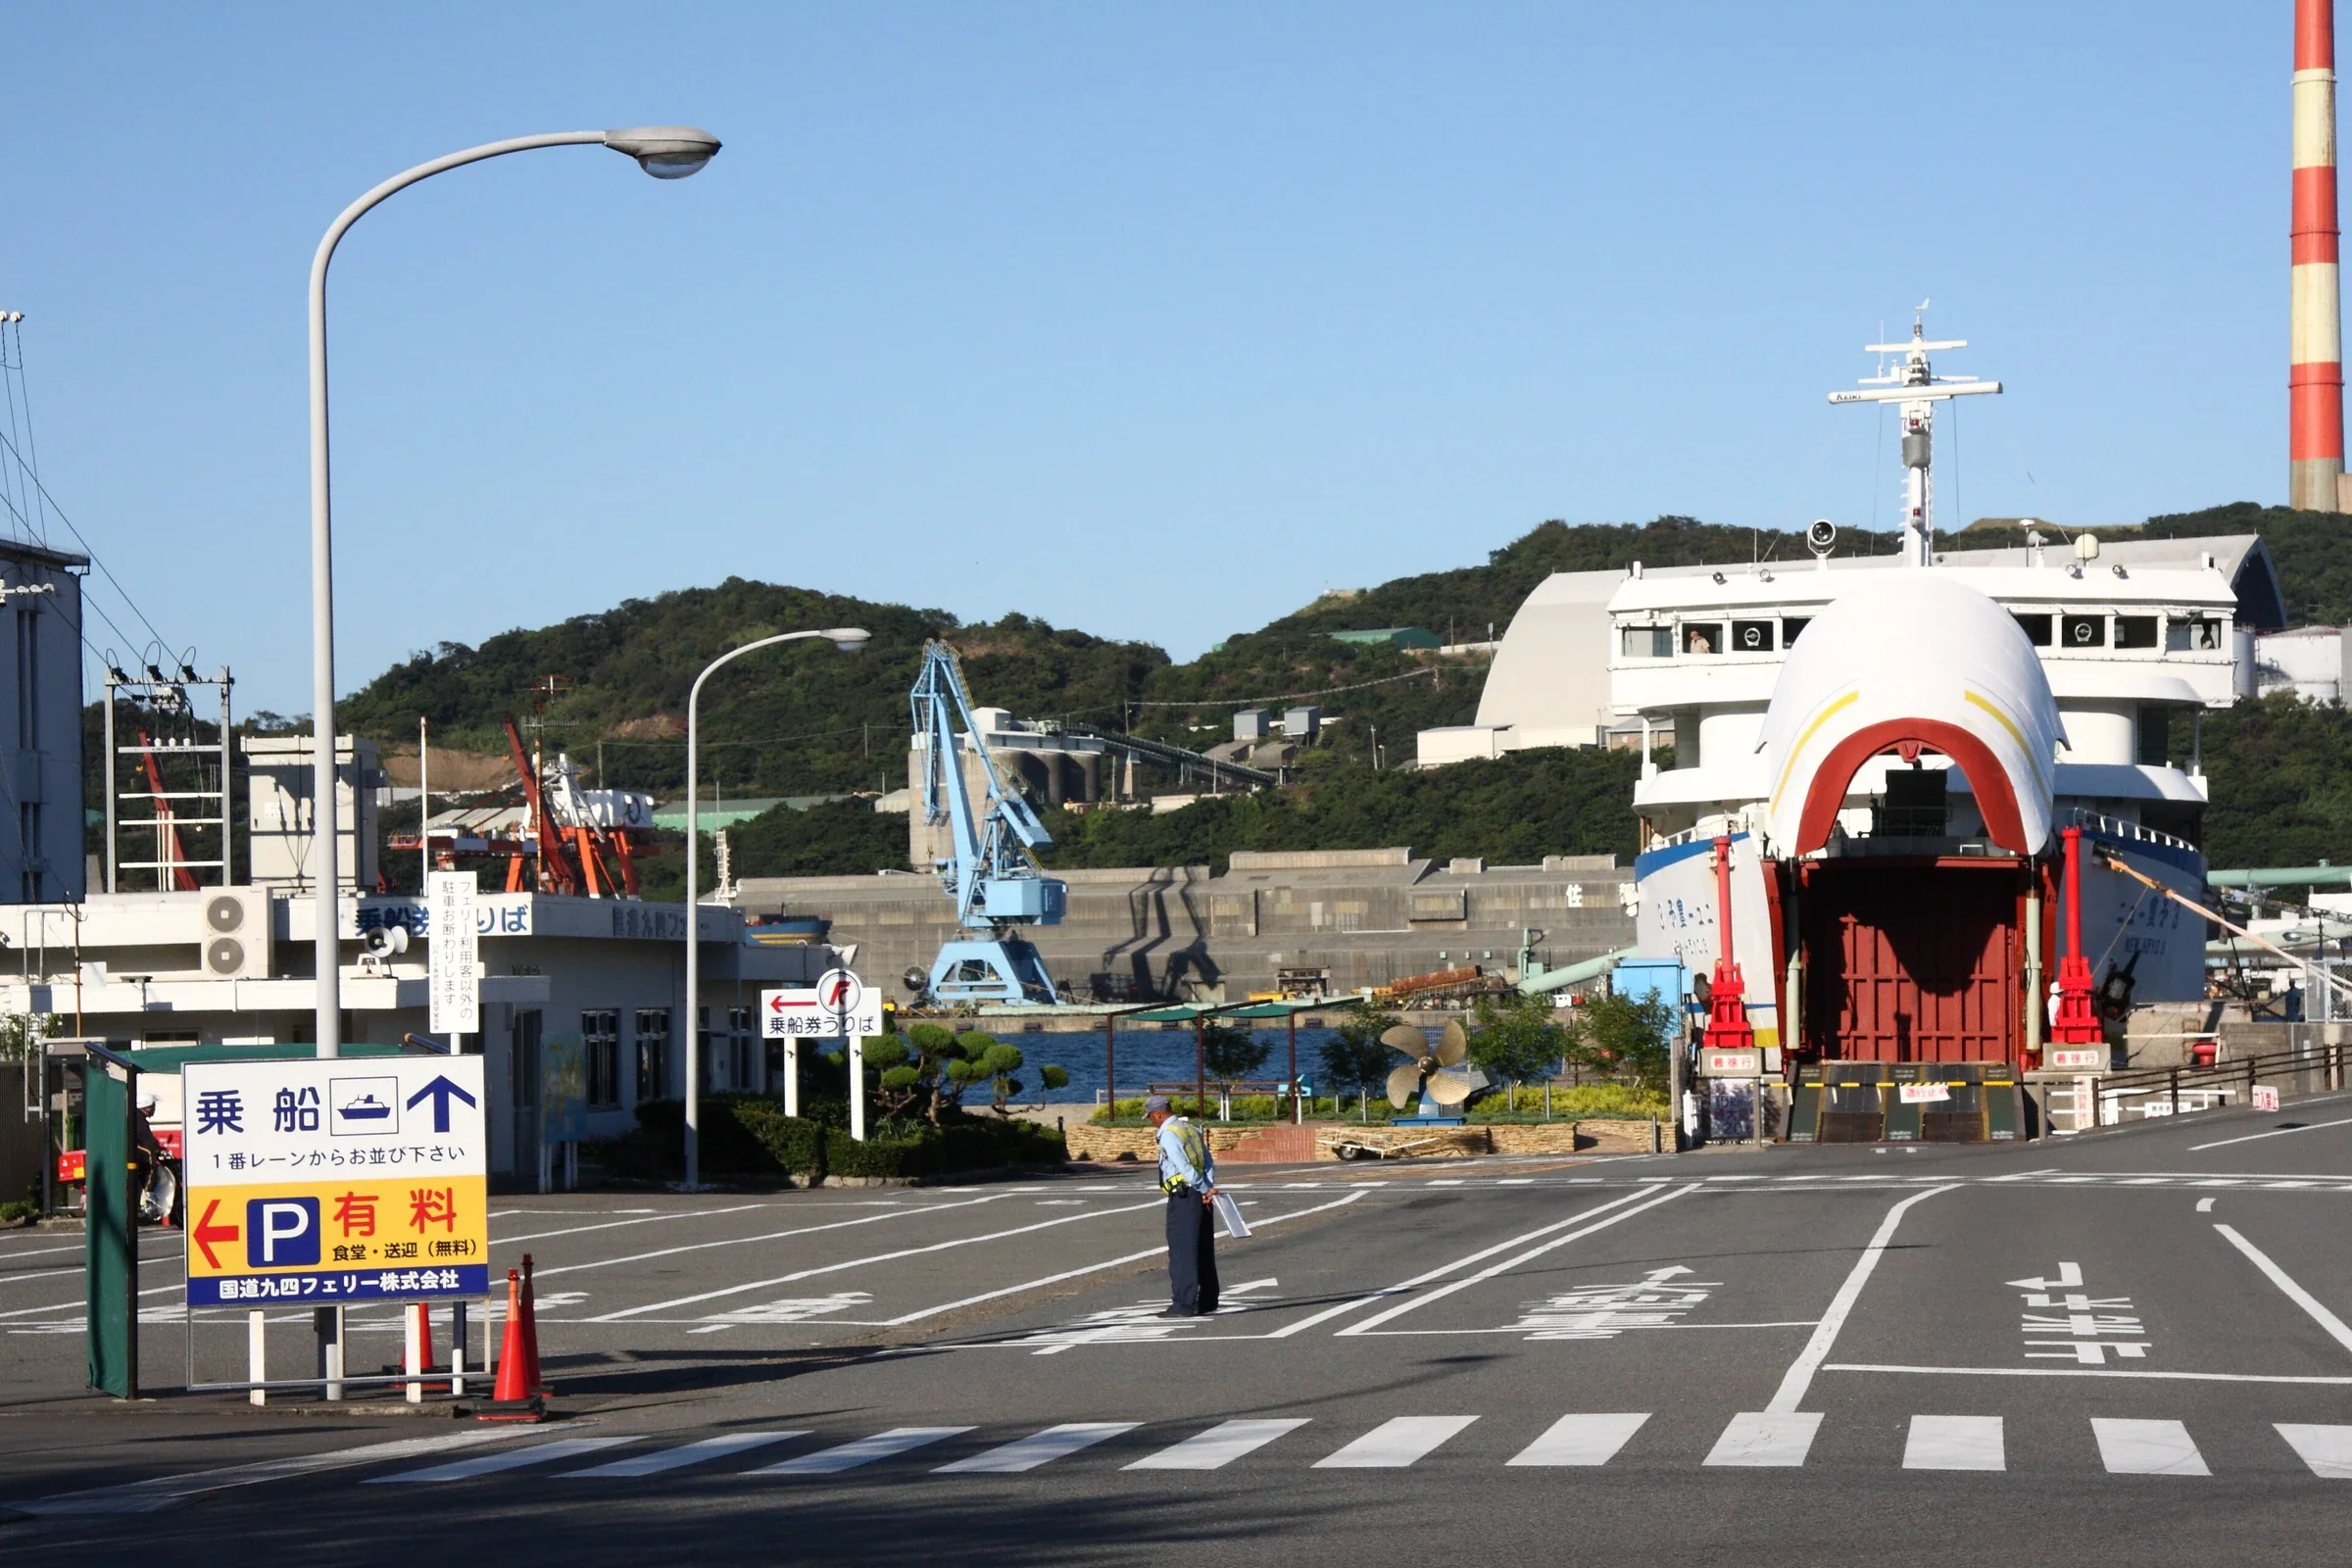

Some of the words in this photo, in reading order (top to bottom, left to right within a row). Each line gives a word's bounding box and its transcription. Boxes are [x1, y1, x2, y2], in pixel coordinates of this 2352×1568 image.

[442, 880, 456, 1005] 駐車お断わりします
[459, 881, 473, 1020] フェリー利用客以外の
[769, 1015, 874, 1035] 乗船券うりば
[195, 1086, 321, 1135] 乗船
[262, 1201, 310, 1262] P
[332, 1187, 458, 1238] 有料
[219, 1268, 461, 1300] 国道九四フェリー株式会社
